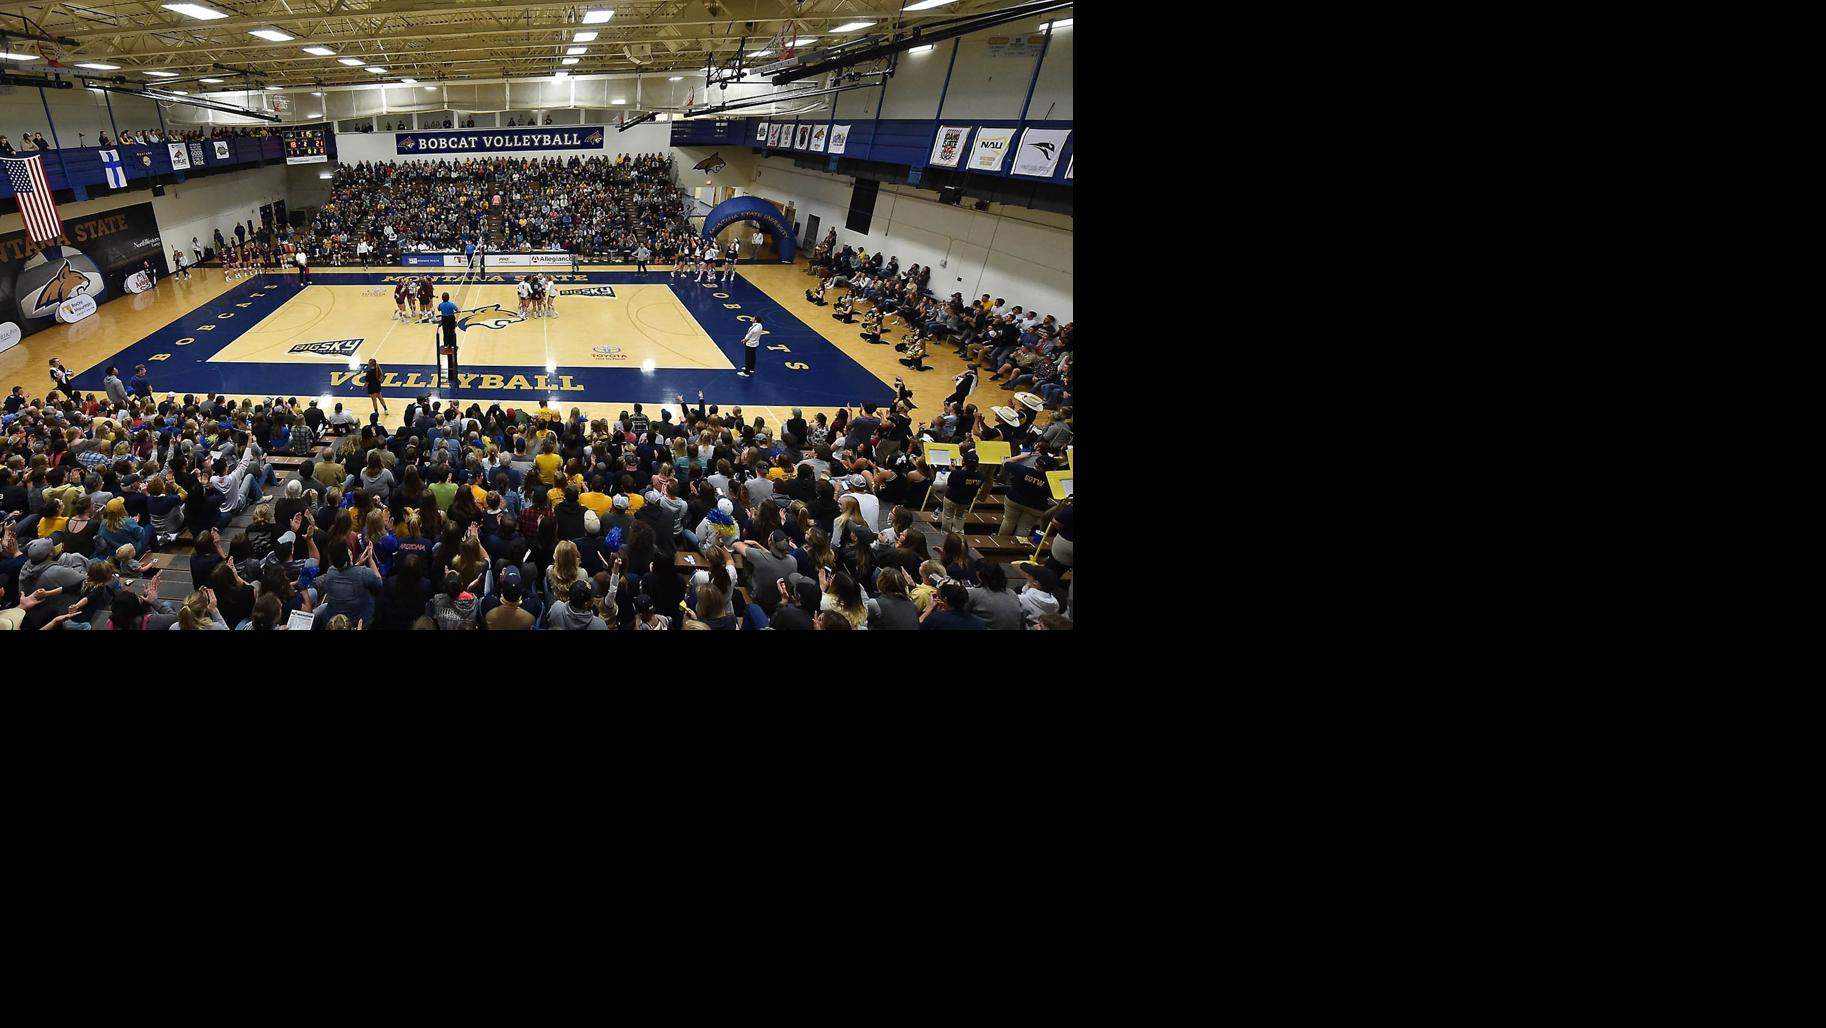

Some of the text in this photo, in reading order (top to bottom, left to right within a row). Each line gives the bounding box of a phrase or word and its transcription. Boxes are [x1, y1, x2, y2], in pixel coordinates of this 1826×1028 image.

[418, 133, 581, 150] BOBCAT VOLLEYBALL
[980, 141, 1003, 149] NAU
[74, 213, 129, 241] STATE
